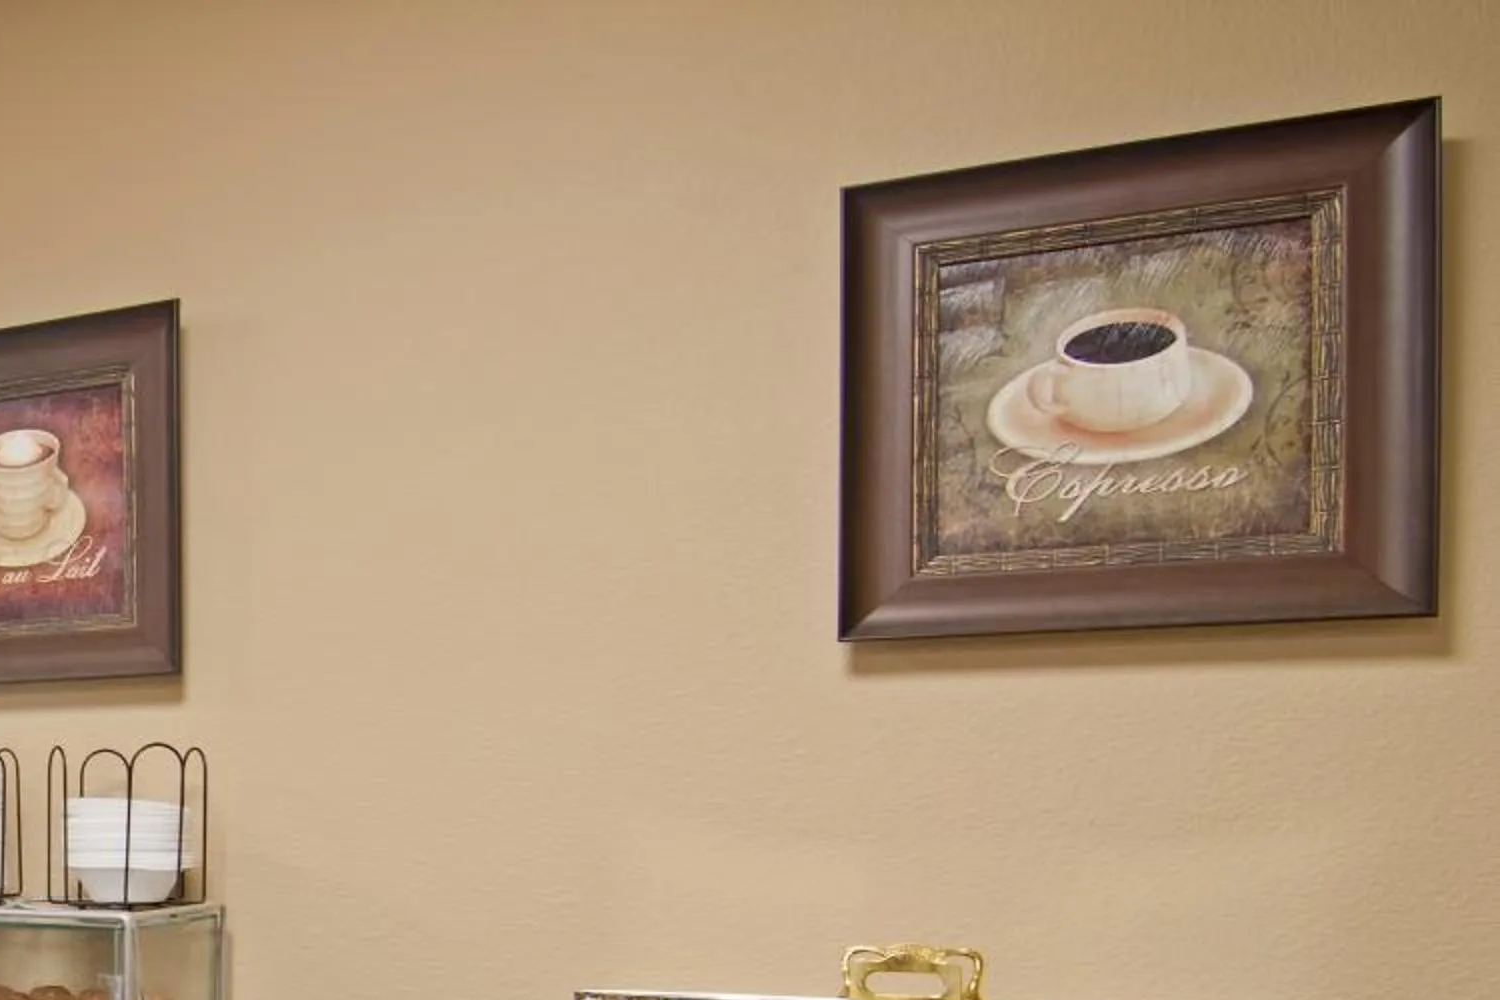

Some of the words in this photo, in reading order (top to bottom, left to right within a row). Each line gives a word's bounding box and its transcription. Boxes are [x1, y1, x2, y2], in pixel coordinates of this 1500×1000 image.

[989, 442, 1249, 522] Espresso
[2, 570, 33, 585] au
[37, 536, 107, 583] Lait
